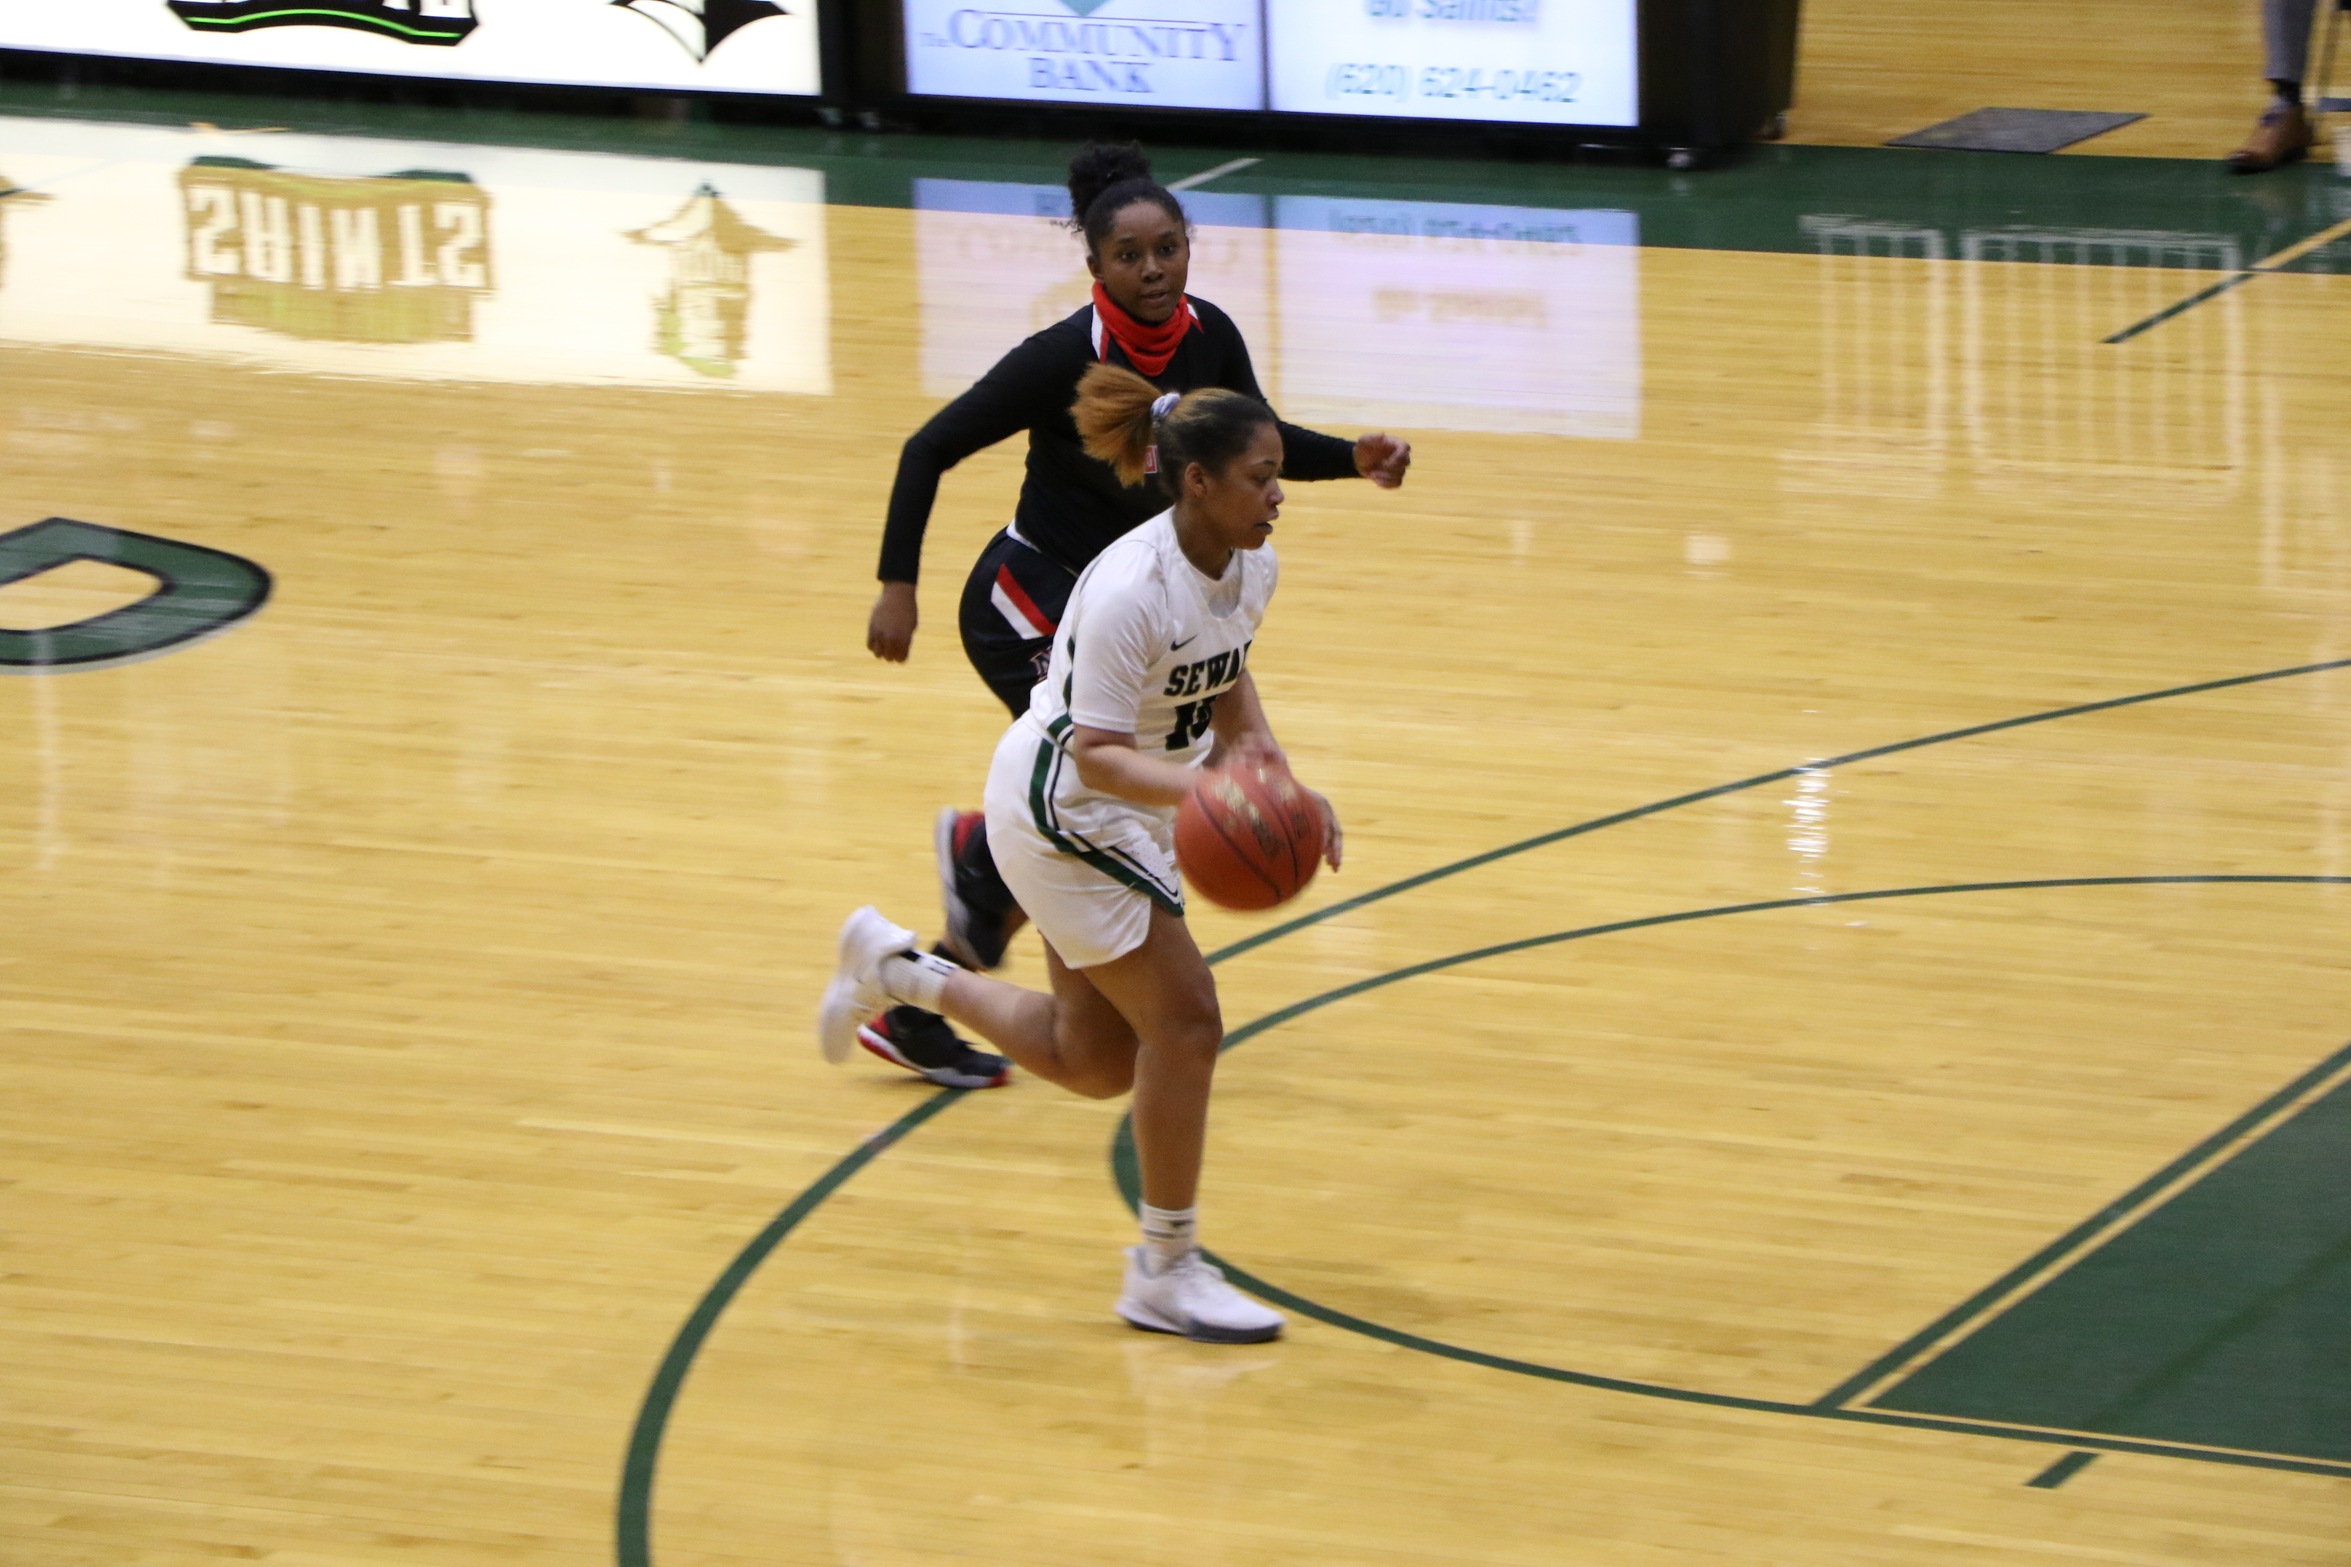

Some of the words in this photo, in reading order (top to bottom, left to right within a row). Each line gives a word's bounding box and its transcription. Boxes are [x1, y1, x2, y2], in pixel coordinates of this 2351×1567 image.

[1028, 57, 1156, 94] BANK
[1325, 62, 1413, 102] (620)
[1420, 66, 1582, 103] 624-0462
[1163, 640, 1253, 697] SEWA
